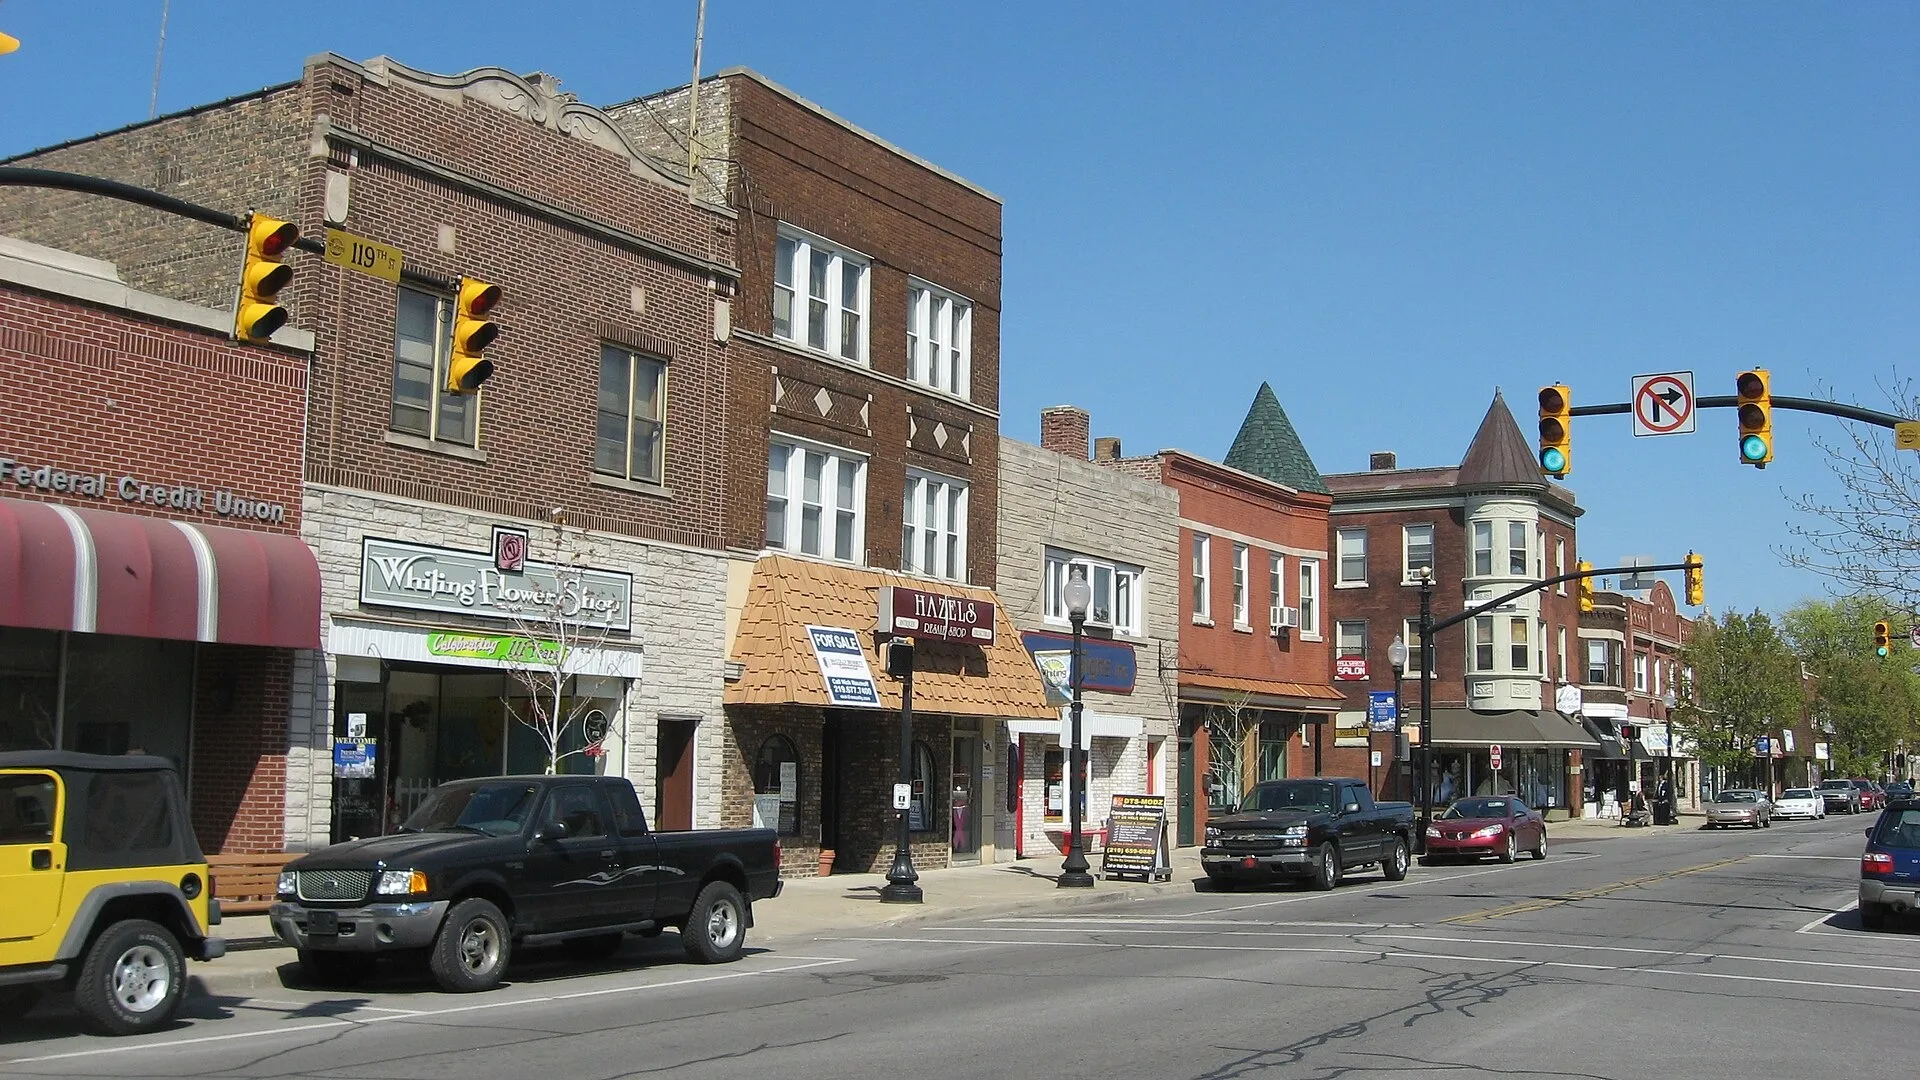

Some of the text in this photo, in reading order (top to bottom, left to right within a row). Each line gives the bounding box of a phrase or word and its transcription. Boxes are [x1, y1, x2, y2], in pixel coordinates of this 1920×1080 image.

[0, 459, 285, 522] Federal Credit Union
[369, 555, 621, 617] Whiting Flower Shop
[914, 594, 977, 624] HAZELS
[814, 633, 858, 650] FOR SALE
[948, 626, 967, 638] SHOP
[434, 634, 500, 655] Celebrating
[1337, 667, 1366, 675] SALON
[335, 737, 378, 745] WELCOME
